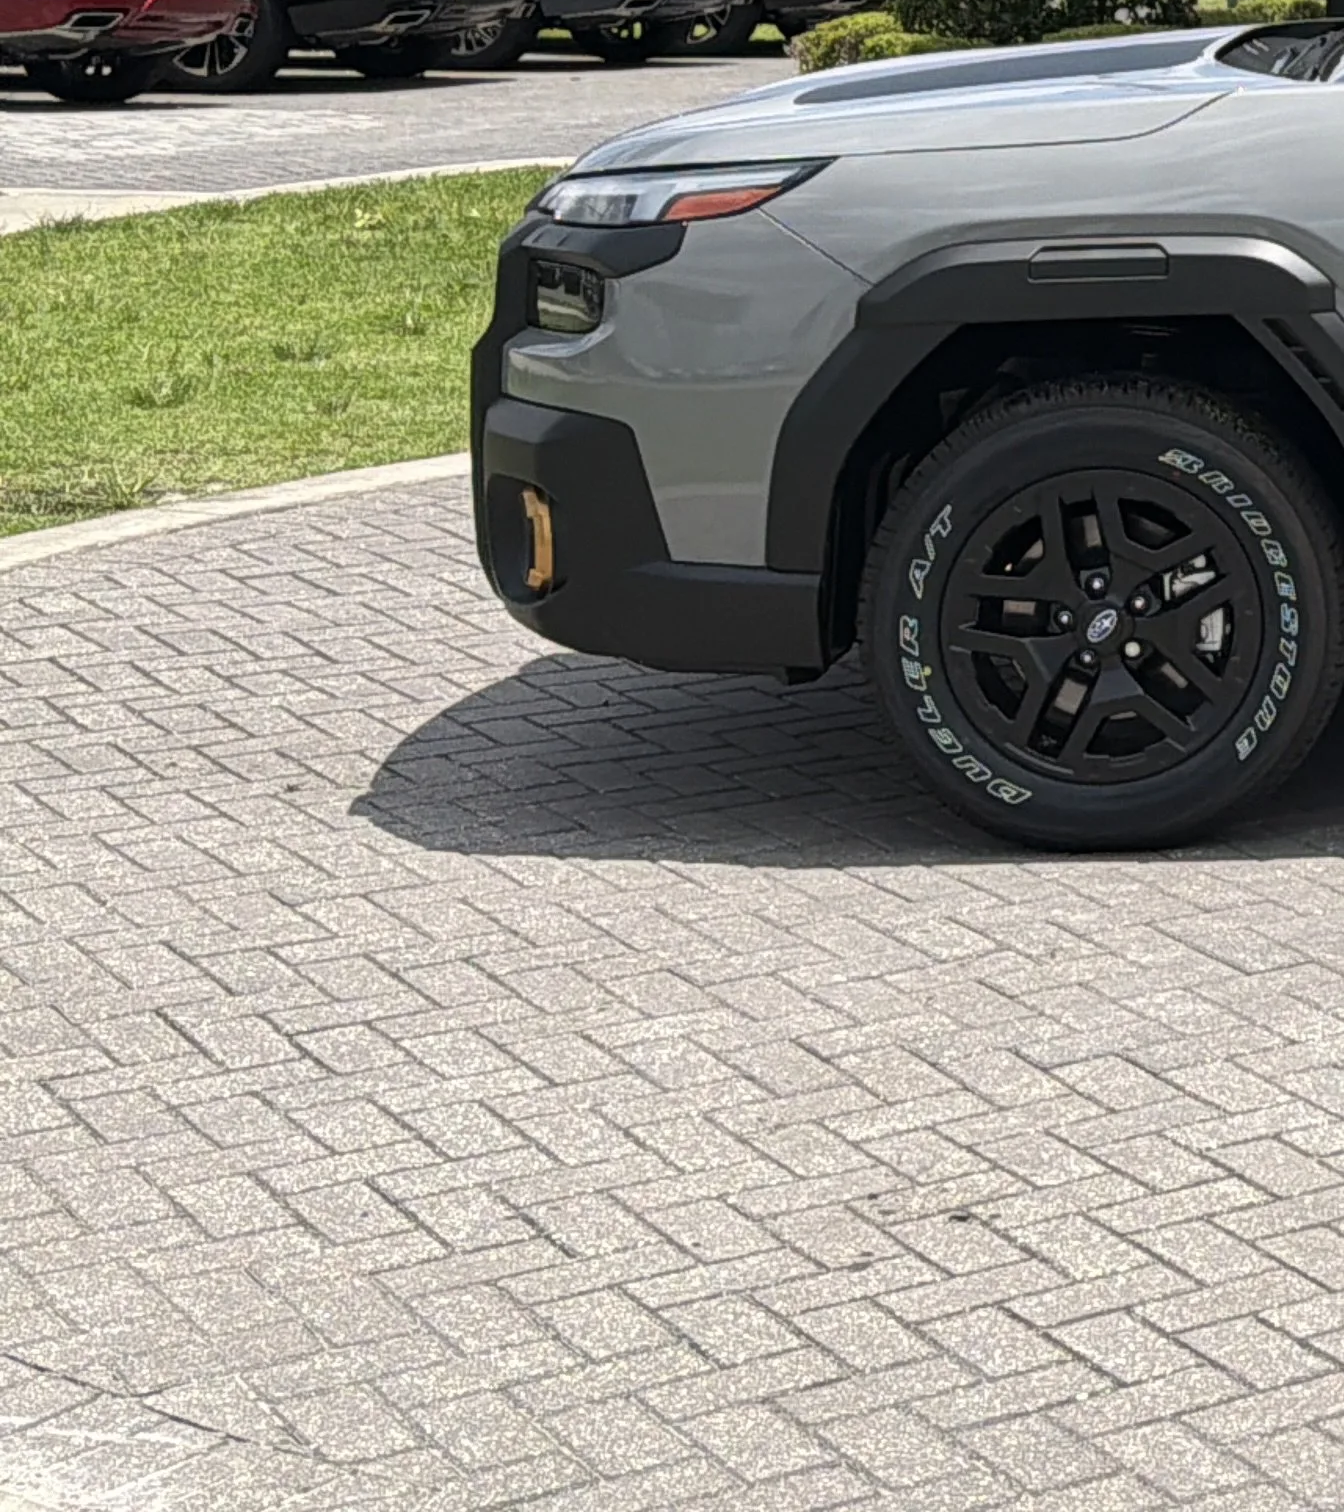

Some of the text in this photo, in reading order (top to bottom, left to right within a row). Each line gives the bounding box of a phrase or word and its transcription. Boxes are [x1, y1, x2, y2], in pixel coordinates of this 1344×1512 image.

[899, 503, 1033, 805] DUELER A/T
[1158, 448, 1299, 761] BRIDGESTONE
